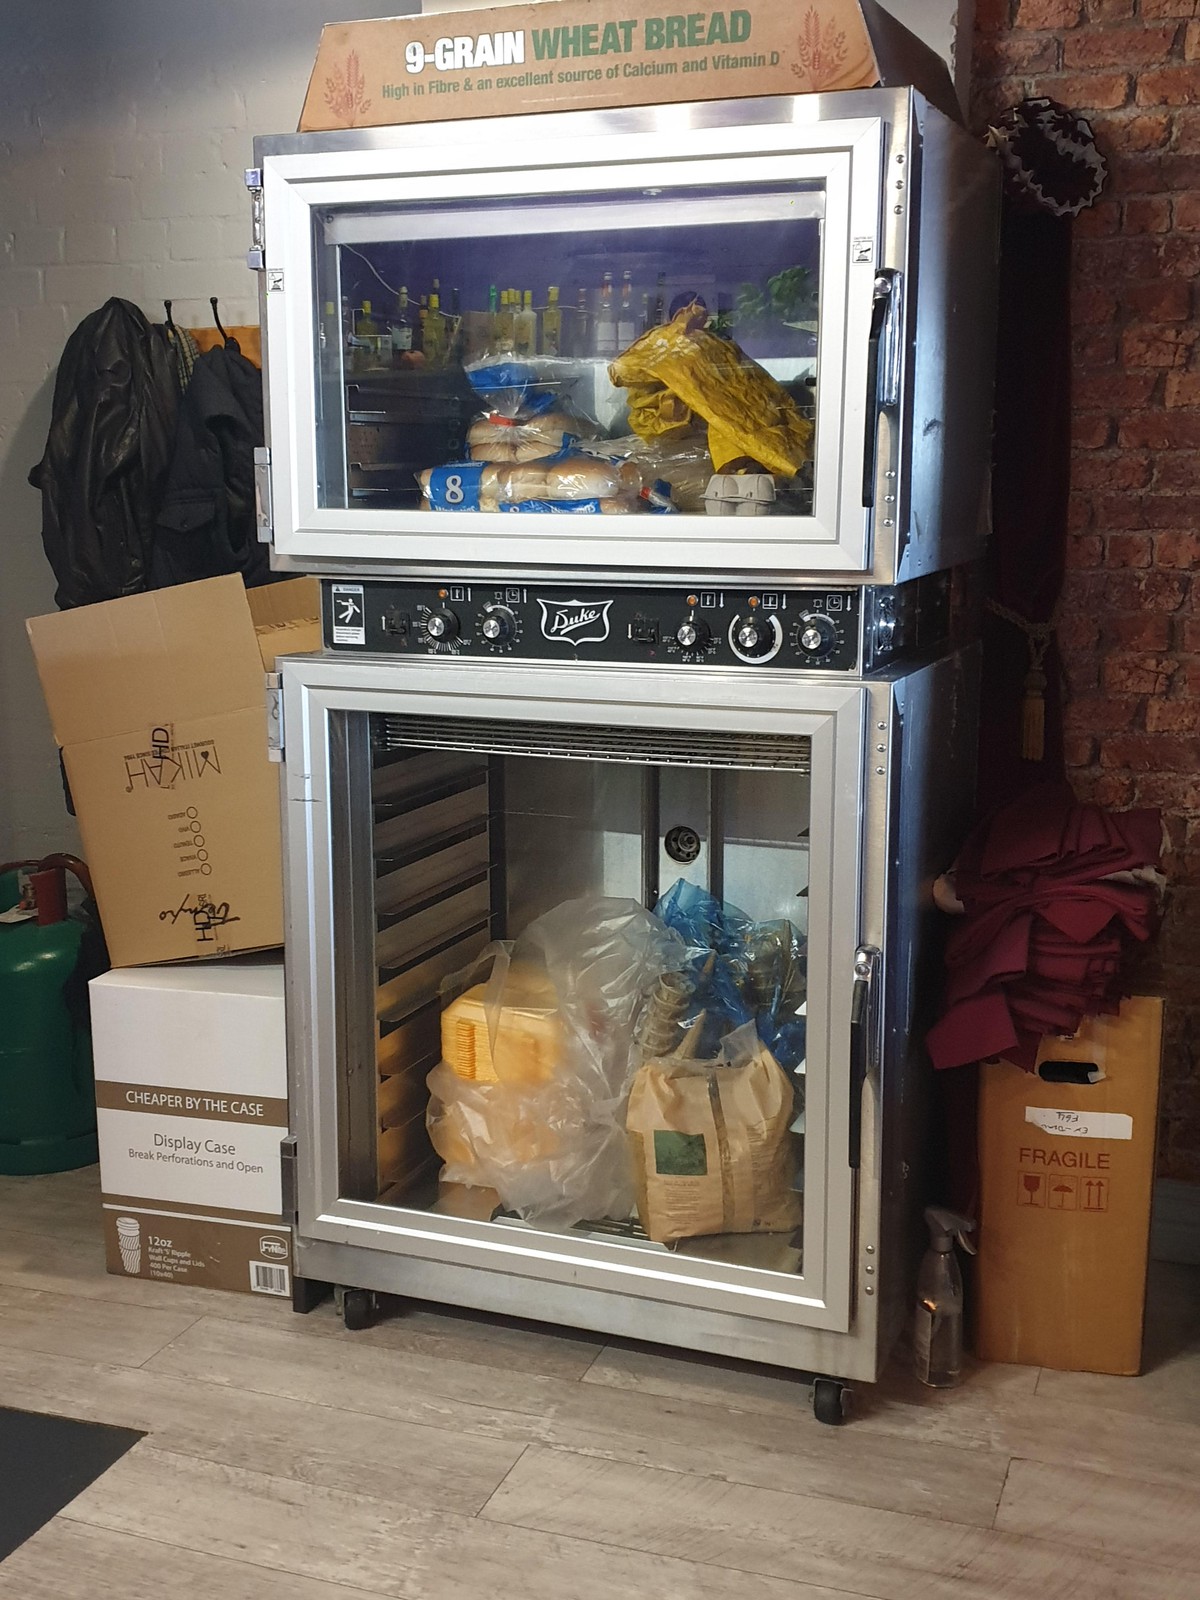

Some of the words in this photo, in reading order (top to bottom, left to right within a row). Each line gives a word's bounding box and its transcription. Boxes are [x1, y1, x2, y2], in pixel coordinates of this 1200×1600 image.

[405, 30, 525, 74] 9-GRAIN
[531, 19, 638, 60] WHEAT
[644, 9, 752, 51] BREAD
[382, 83, 410, 100] High
[413, 82, 425, 96] in
[428, 78, 460, 94] Fibre
[463, 77, 473, 91] &
[477, 77, 492, 90] an
[496, 70, 554, 89] excellent
[557, 67, 602, 83] source
[606, 64, 620, 79] of
[623, 61, 678, 78] Calcium
[682, 57, 708, 73] and
[712, 52, 766, 70] Vitamin
[769, 51, 780, 66] D
[445, 474, 464, 504] 8
[550, 608, 600, 635] Duke
[126, 1090, 183, 1108] CHEAPER
[185, 1096, 201, 1110] BY
[202, 1098, 228, 1113] THE
[230, 1101, 264, 1117] CASE
[154, 1133, 201, 1154] Display
[204, 1139, 236, 1155] Case
[128, 1148, 154, 1161] Break
[156, 1151, 214, 1168] Perforations
[216, 1160, 234, 1170] and
[236, 1161, 264, 1174] Open
[1019, 1148, 1111, 1169] FRAGILE
[148, 1235, 173, 1248] 12oz
